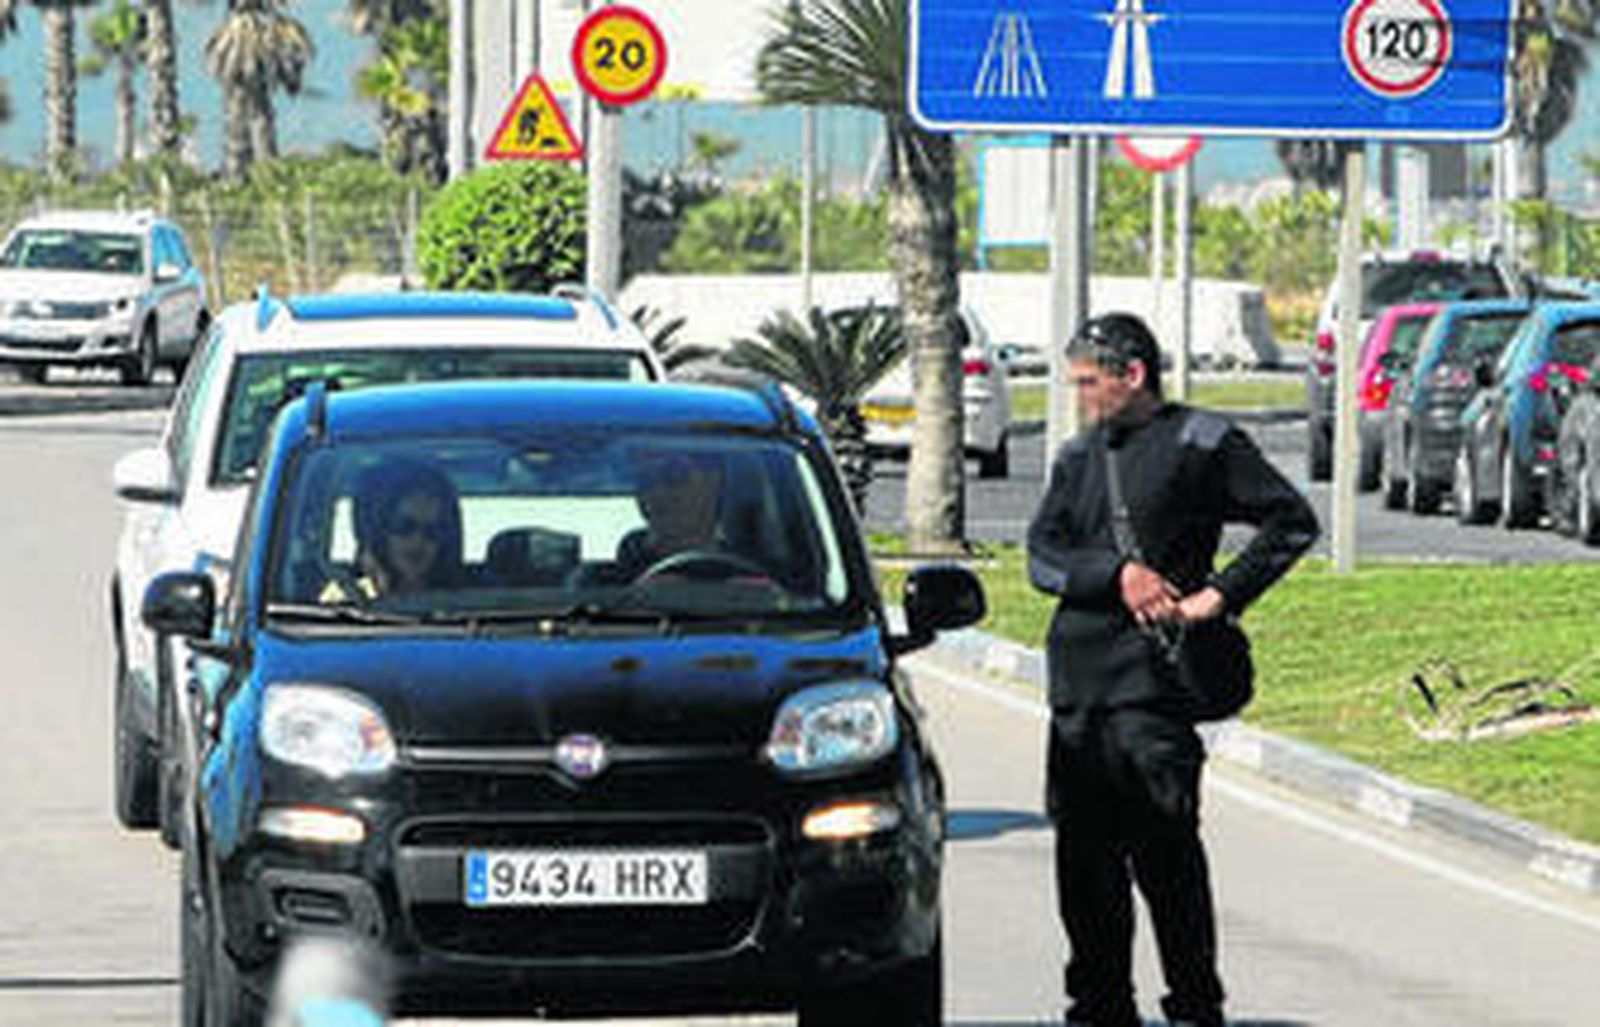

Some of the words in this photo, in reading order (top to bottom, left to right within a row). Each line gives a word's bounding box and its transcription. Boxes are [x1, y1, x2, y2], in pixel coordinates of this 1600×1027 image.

[595, 37, 646, 71] 20
[1367, 21, 1426, 58] 120
[493, 860, 595, 897] 9434
[615, 860, 694, 897] HRX
